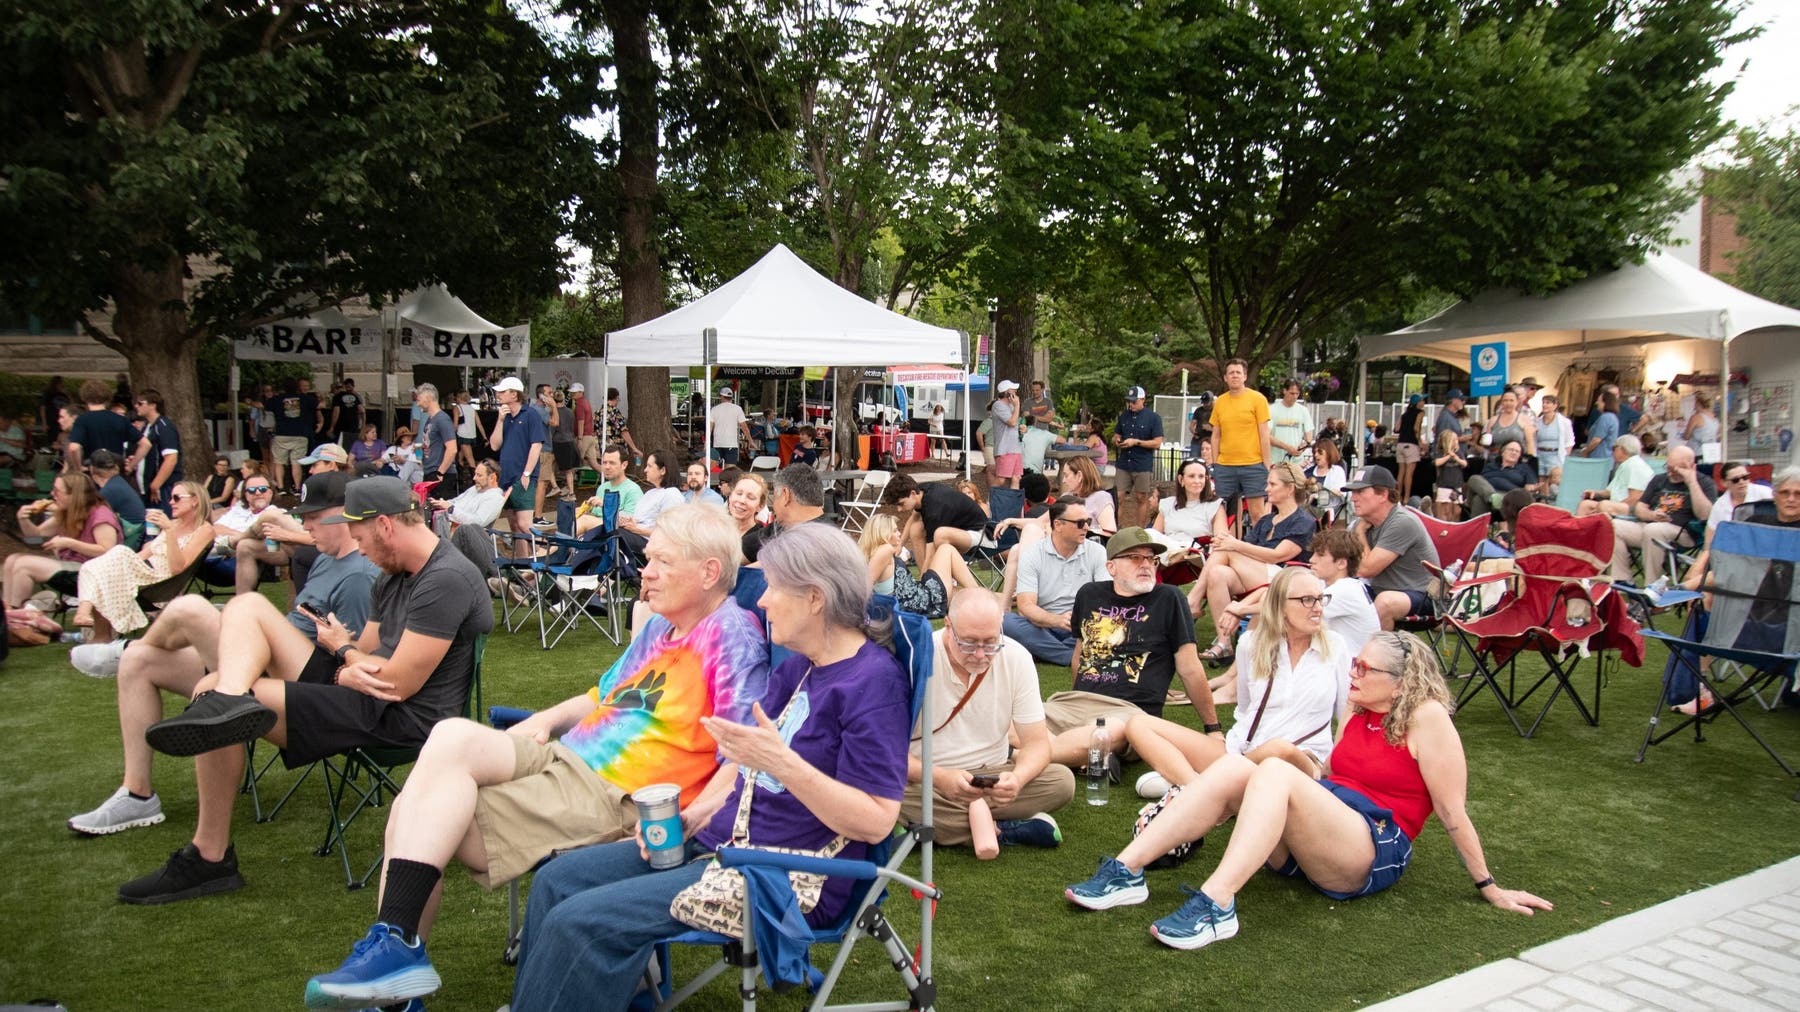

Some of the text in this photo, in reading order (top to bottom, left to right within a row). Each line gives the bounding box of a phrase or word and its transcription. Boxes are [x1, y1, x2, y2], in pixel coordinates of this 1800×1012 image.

[272, 325, 348, 355] BAR
[433, 329, 500, 359] BAR
[723, 366, 758, 375] Welcome
[764, 367, 796, 375] Decatur
[670, 384, 687, 393] ving?
